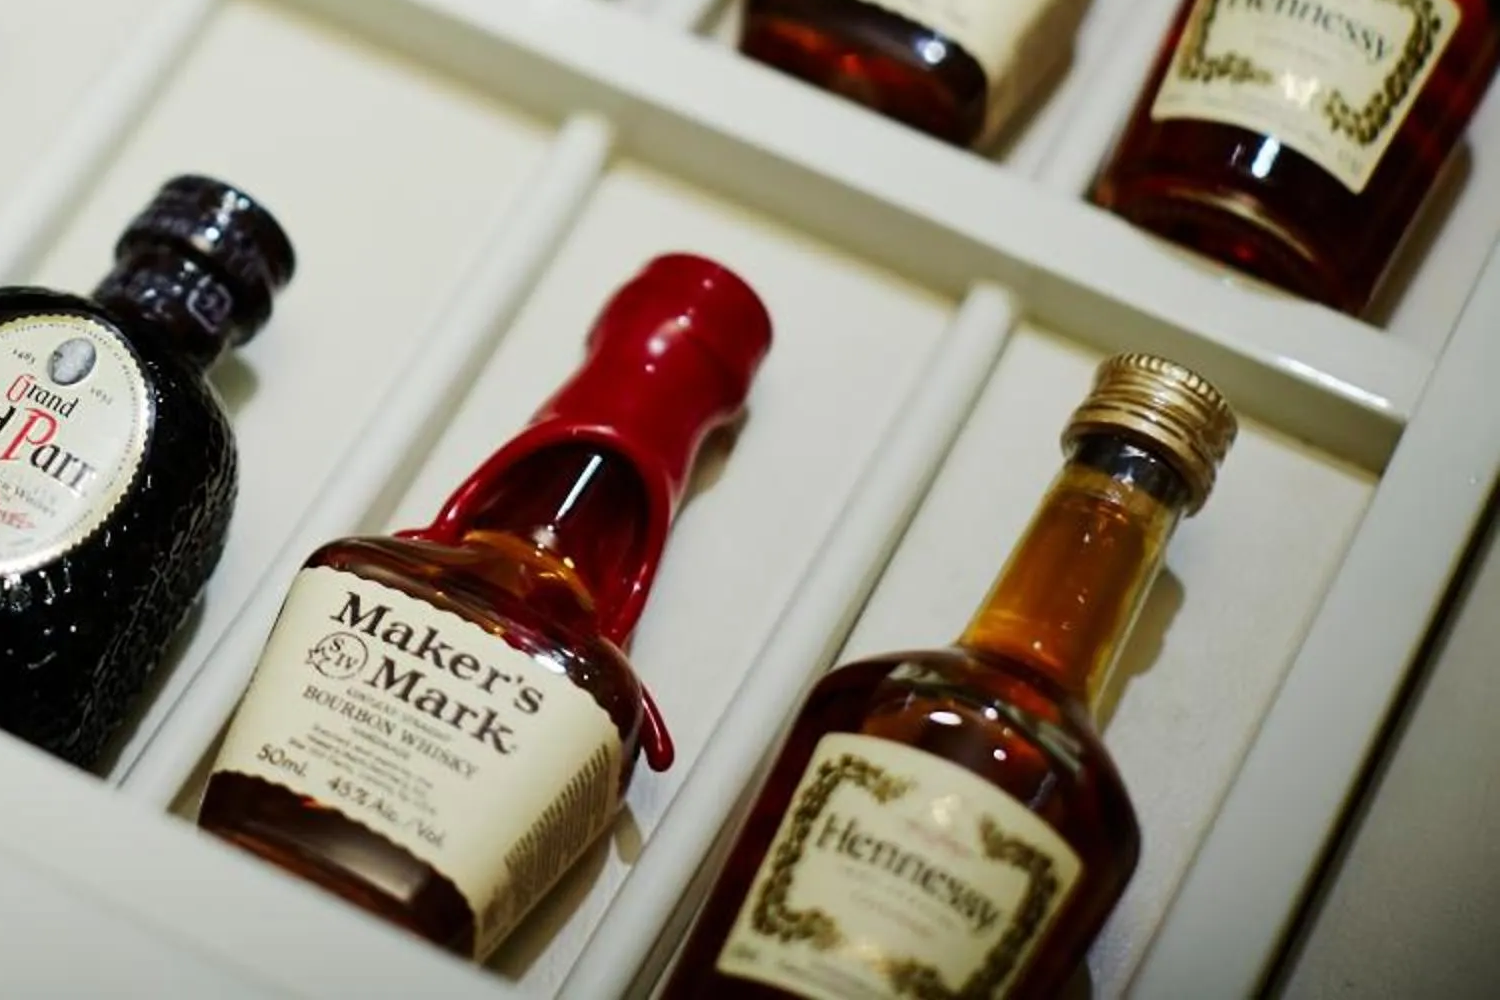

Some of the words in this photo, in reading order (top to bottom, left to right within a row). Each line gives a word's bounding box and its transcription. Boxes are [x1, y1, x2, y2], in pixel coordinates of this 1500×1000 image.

[5, 372, 80, 419] Grand
[329, 590, 545, 717] Maker's
[302, 684, 397, 738] BOURBON
[400, 727, 478, 780] WHISKY
[364, 654, 514, 756] Mark
[813, 812, 1001, 934] Hennessy
